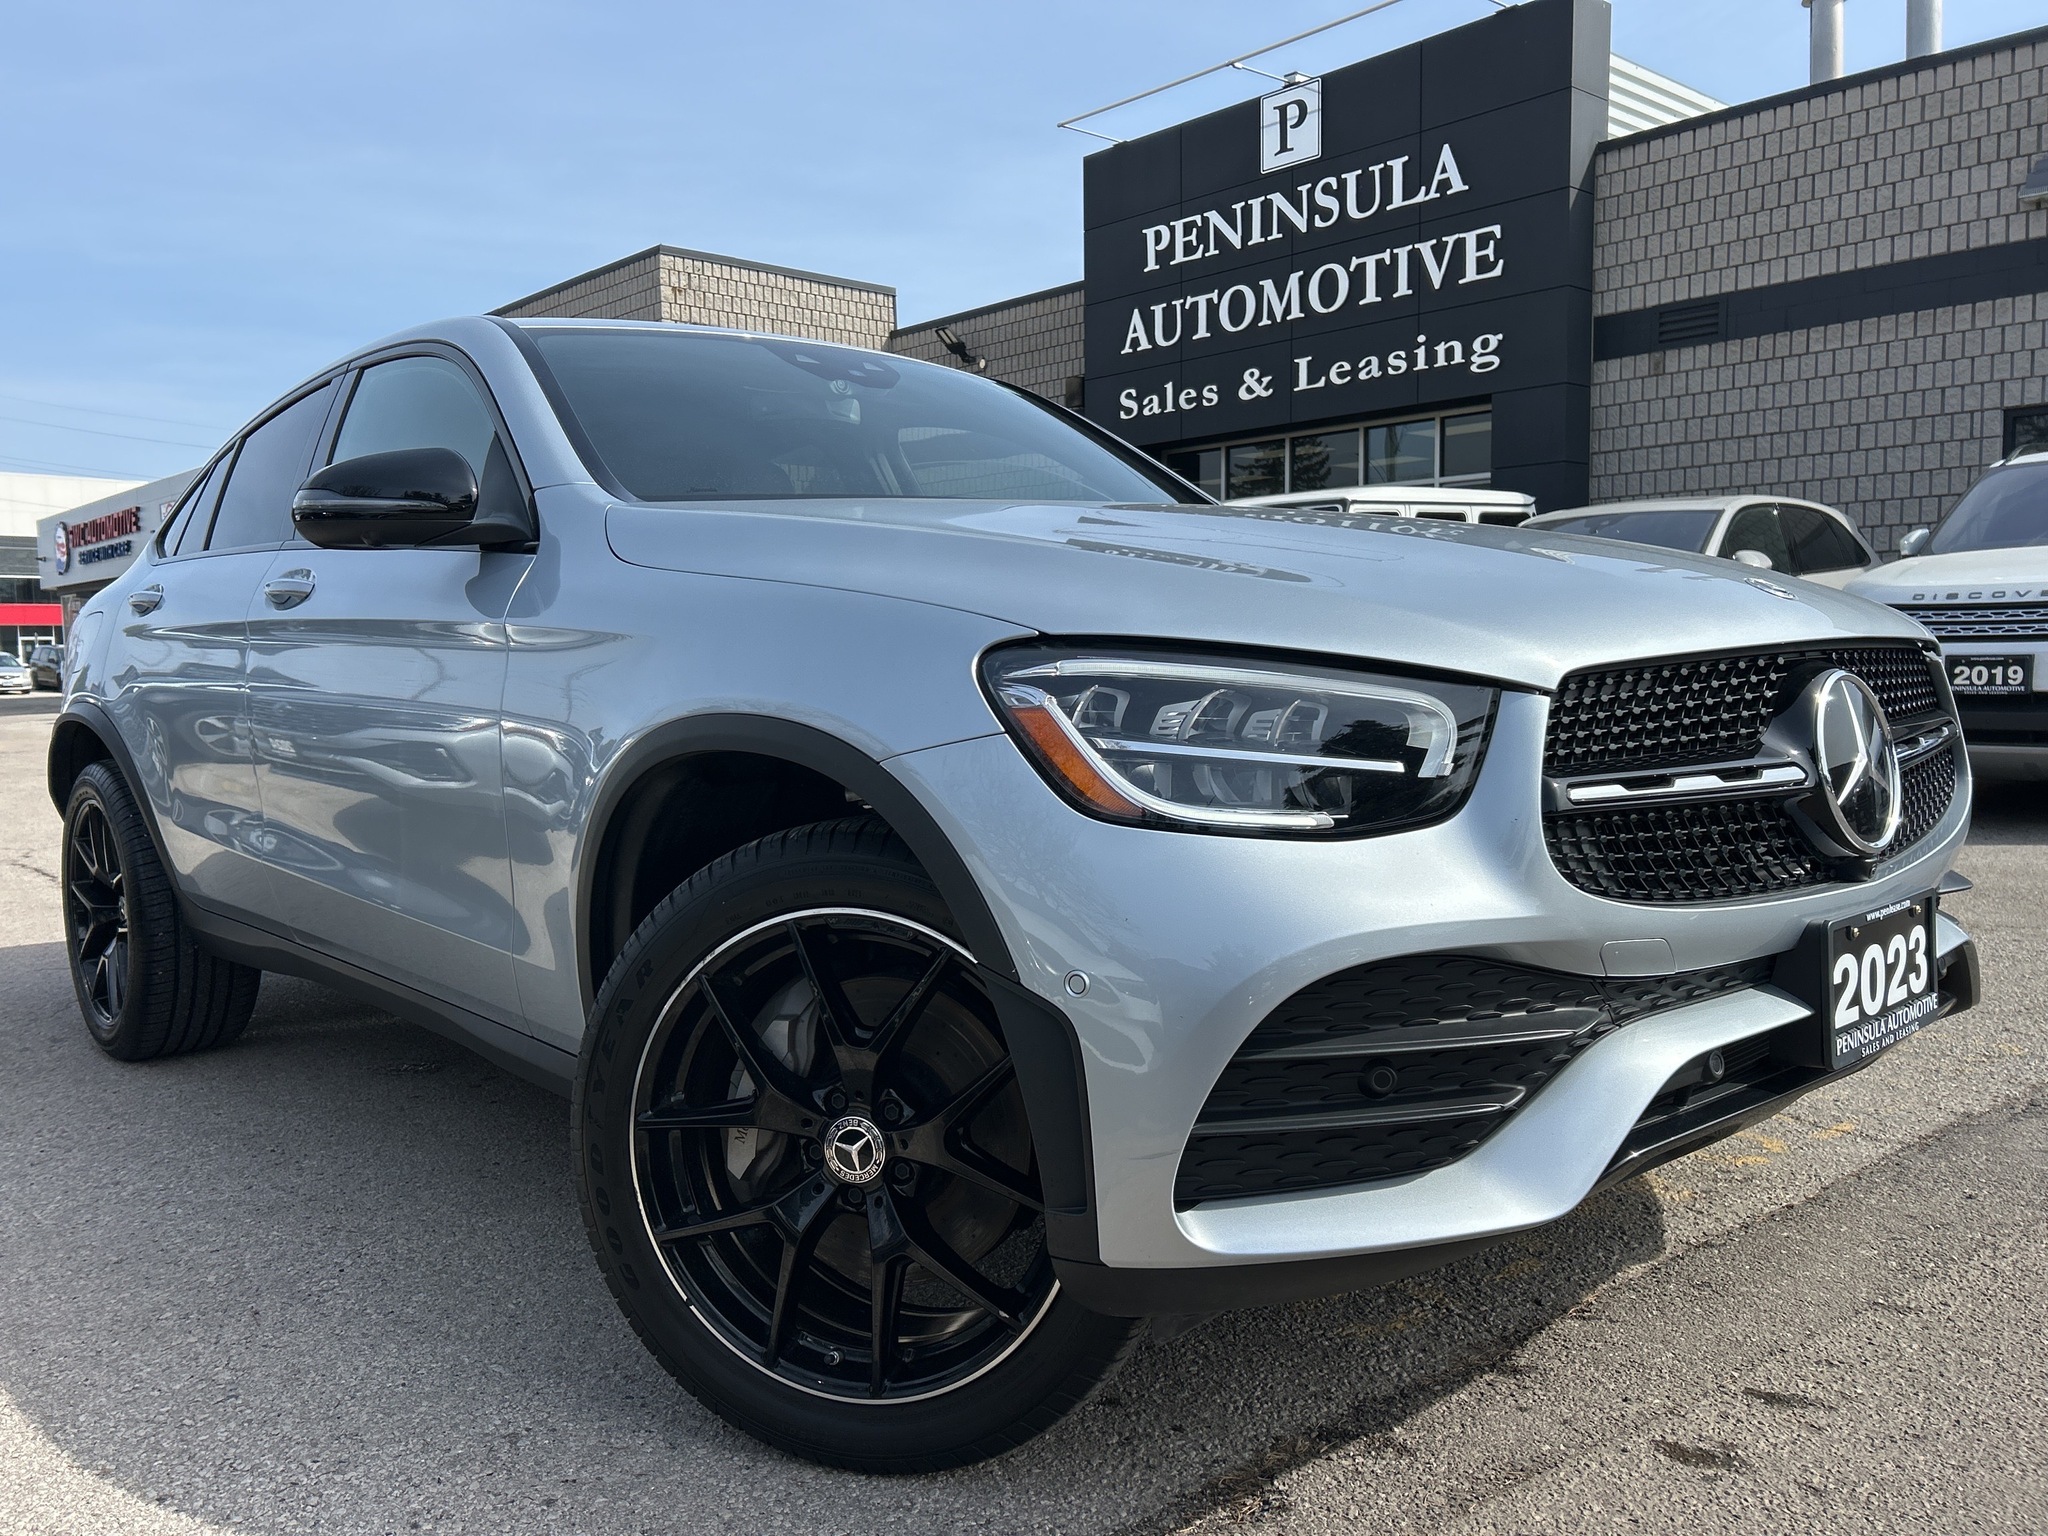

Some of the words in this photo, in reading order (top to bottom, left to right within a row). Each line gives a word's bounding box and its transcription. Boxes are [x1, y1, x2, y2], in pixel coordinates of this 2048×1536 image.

[1273, 98, 1308, 156] P
[1142, 143, 1469, 273] PENINSULA
[1120, 224, 1504, 355] AUTOMOTIVE
[1119, 379, 1219, 420] Sales
[1237, 368, 1274, 401] &
[1293, 333, 1504, 392] Leasing
[87, 506, 141, 543] AUTOMOTIVE
[1953, 665, 2024, 686] 2019
[1833, 924, 1928, 1029] 2023
[1836, 1020, 1887, 1056] PENINSULA
[1887, 993, 1938, 1030] AUTOMOTIVE
[1861, 1041, 1880, 1058] SALES
[1881, 1033, 1895, 1048] AND
[1896, 1022, 1920, 1041] LEASING
[837, 1118, 859, 1130] BENZ
[839, 1164, 879, 1181] MERCEDES
